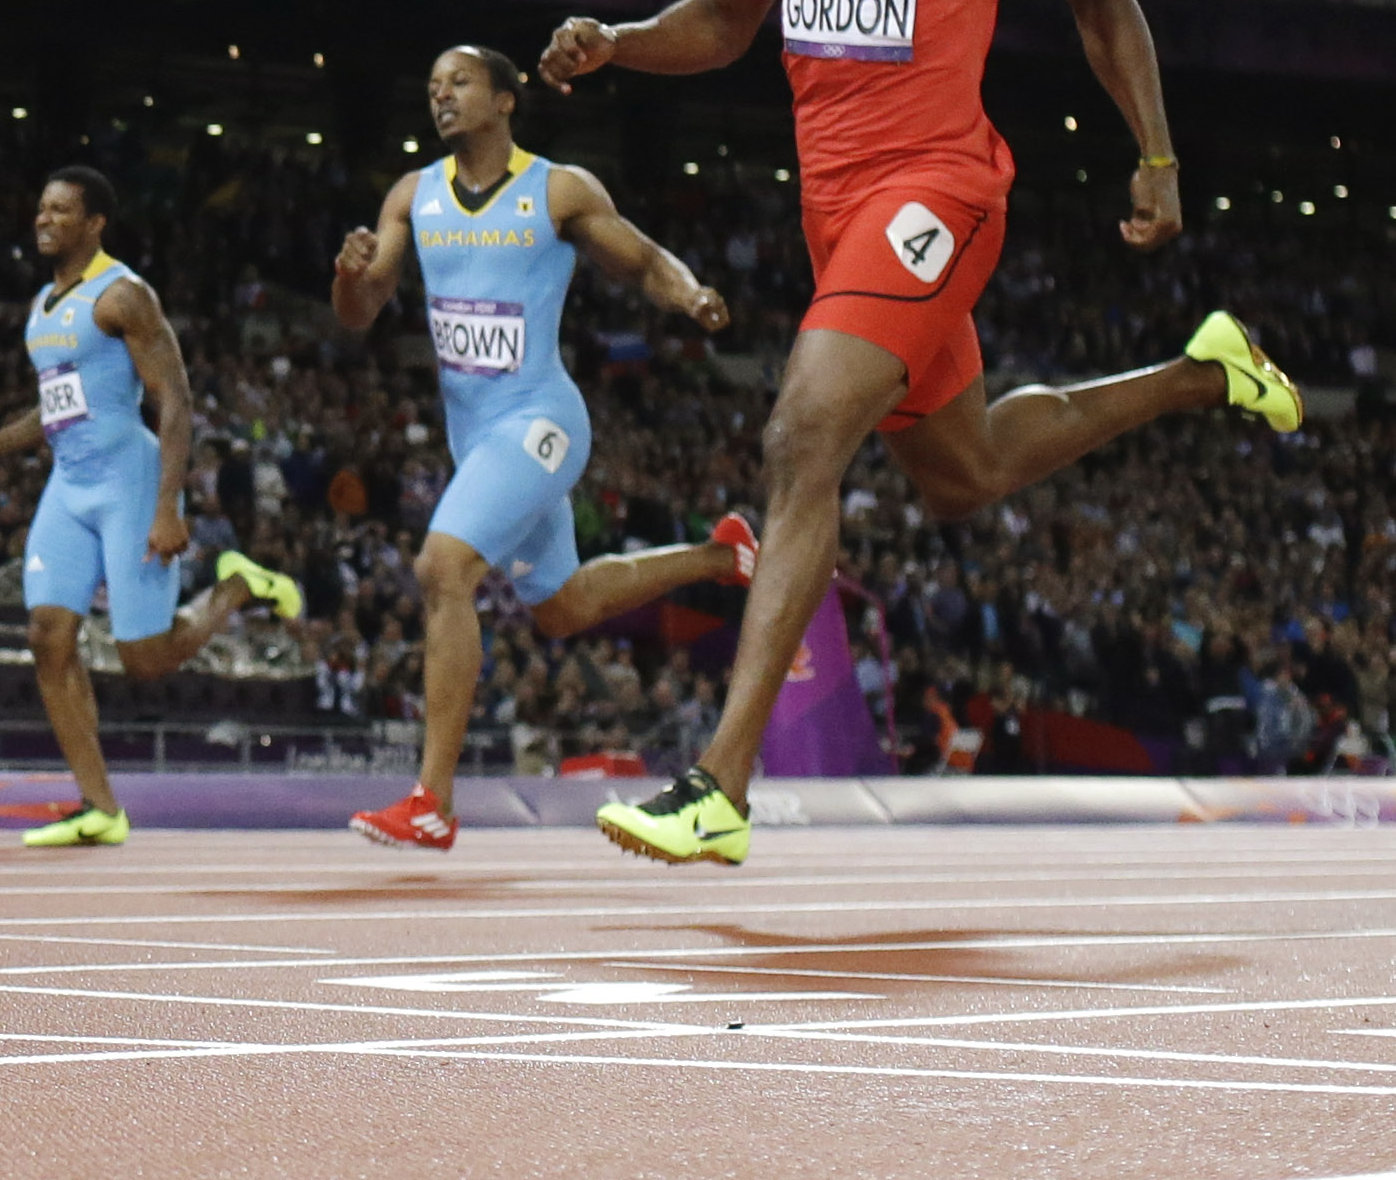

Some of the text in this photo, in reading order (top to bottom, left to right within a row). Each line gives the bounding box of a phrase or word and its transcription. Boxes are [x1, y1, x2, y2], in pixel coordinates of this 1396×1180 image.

[419, 228, 536, 248] BAHAMAS
[903, 227, 940, 266] 4
[433, 320, 519, 361] BROWN
[537, 431, 558, 453] 6
